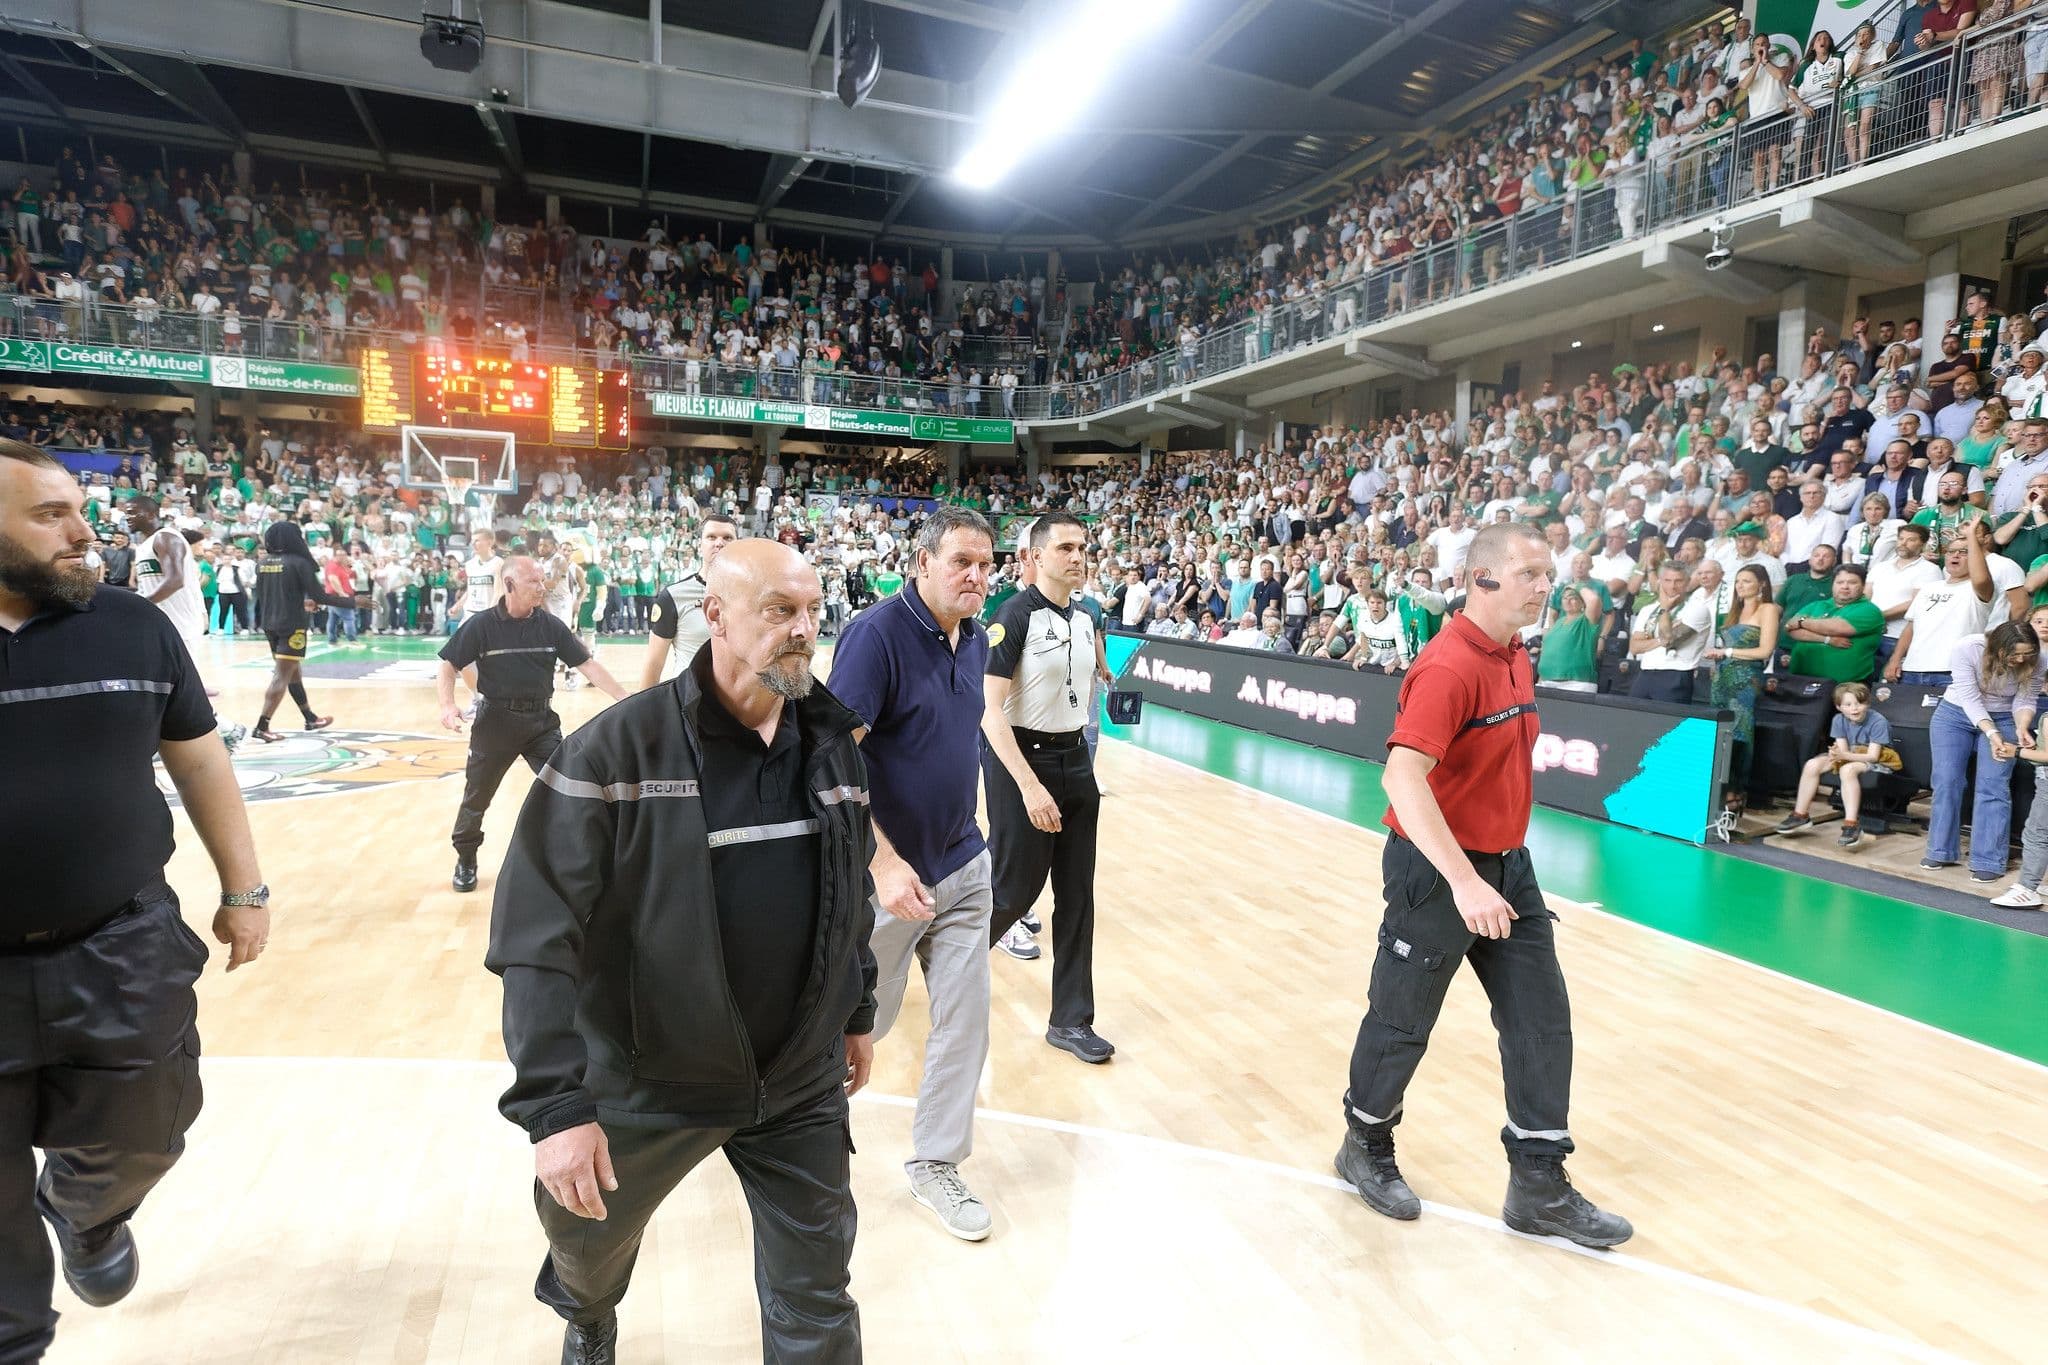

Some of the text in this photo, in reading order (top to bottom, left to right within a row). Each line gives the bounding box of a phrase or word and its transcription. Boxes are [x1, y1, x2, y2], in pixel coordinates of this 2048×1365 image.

[55, 347, 203, 372] Crédit Mutuel
[248, 364, 284, 375] Région
[248, 374, 358, 393] Hauts-de-France
[656, 394, 756, 419] MEUBLES FLAHAUT
[831, 411, 857, 420] Région
[764, 412, 799, 422] LE TOUQUET
[831, 419, 910, 433] Hauts-de-France
[1152, 657, 1212, 694] Kappa
[1265, 678, 1357, 724] Kappa
[1531, 732, 1600, 776] pa
[708, 830, 750, 845] CURITE
